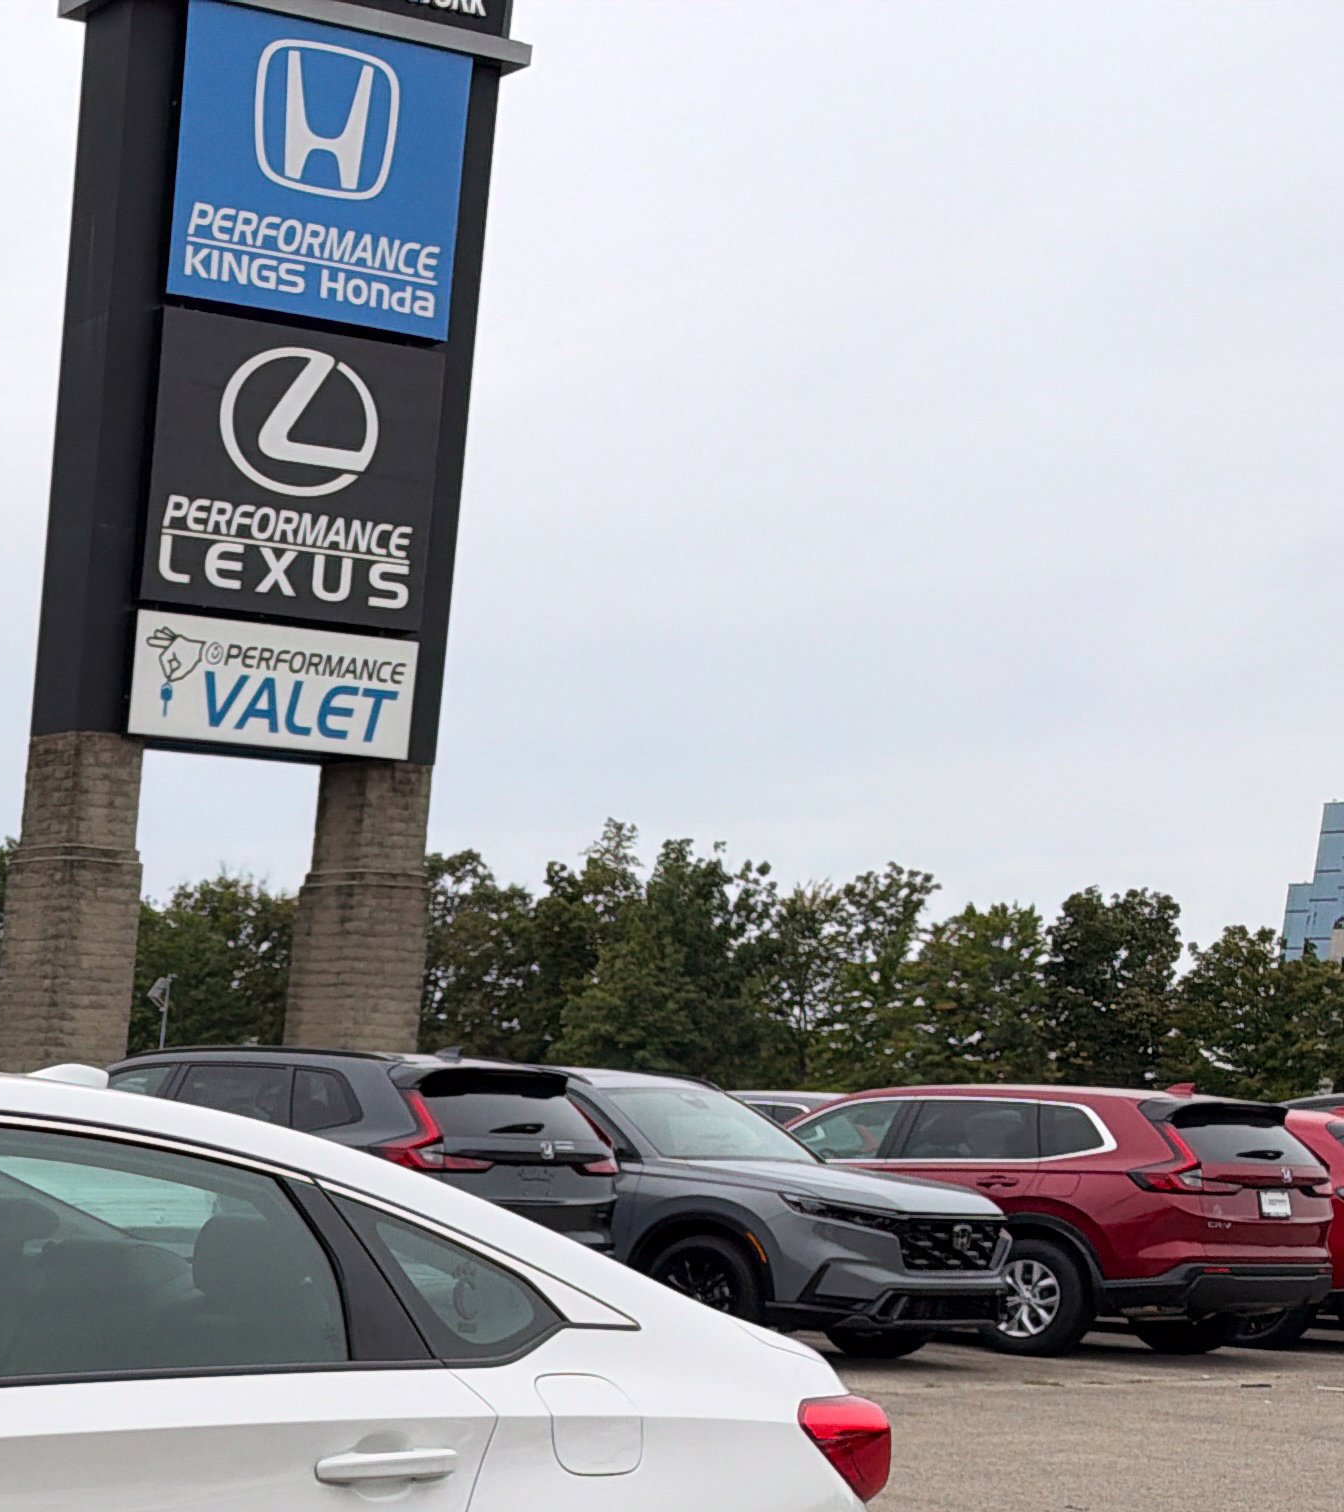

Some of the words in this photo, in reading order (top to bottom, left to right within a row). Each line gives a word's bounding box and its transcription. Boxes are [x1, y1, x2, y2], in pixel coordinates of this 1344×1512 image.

[187, 202, 441, 278] PERFORMANCE
[185, 246, 306, 294] KINGS
[321, 269, 435, 318] Honda
[162, 495, 413, 558] PERFORMANCE
[158, 535, 410, 608] LEXUS
[224, 644, 406, 685] PERFORMANCE
[204, 671, 398, 744] VALET
